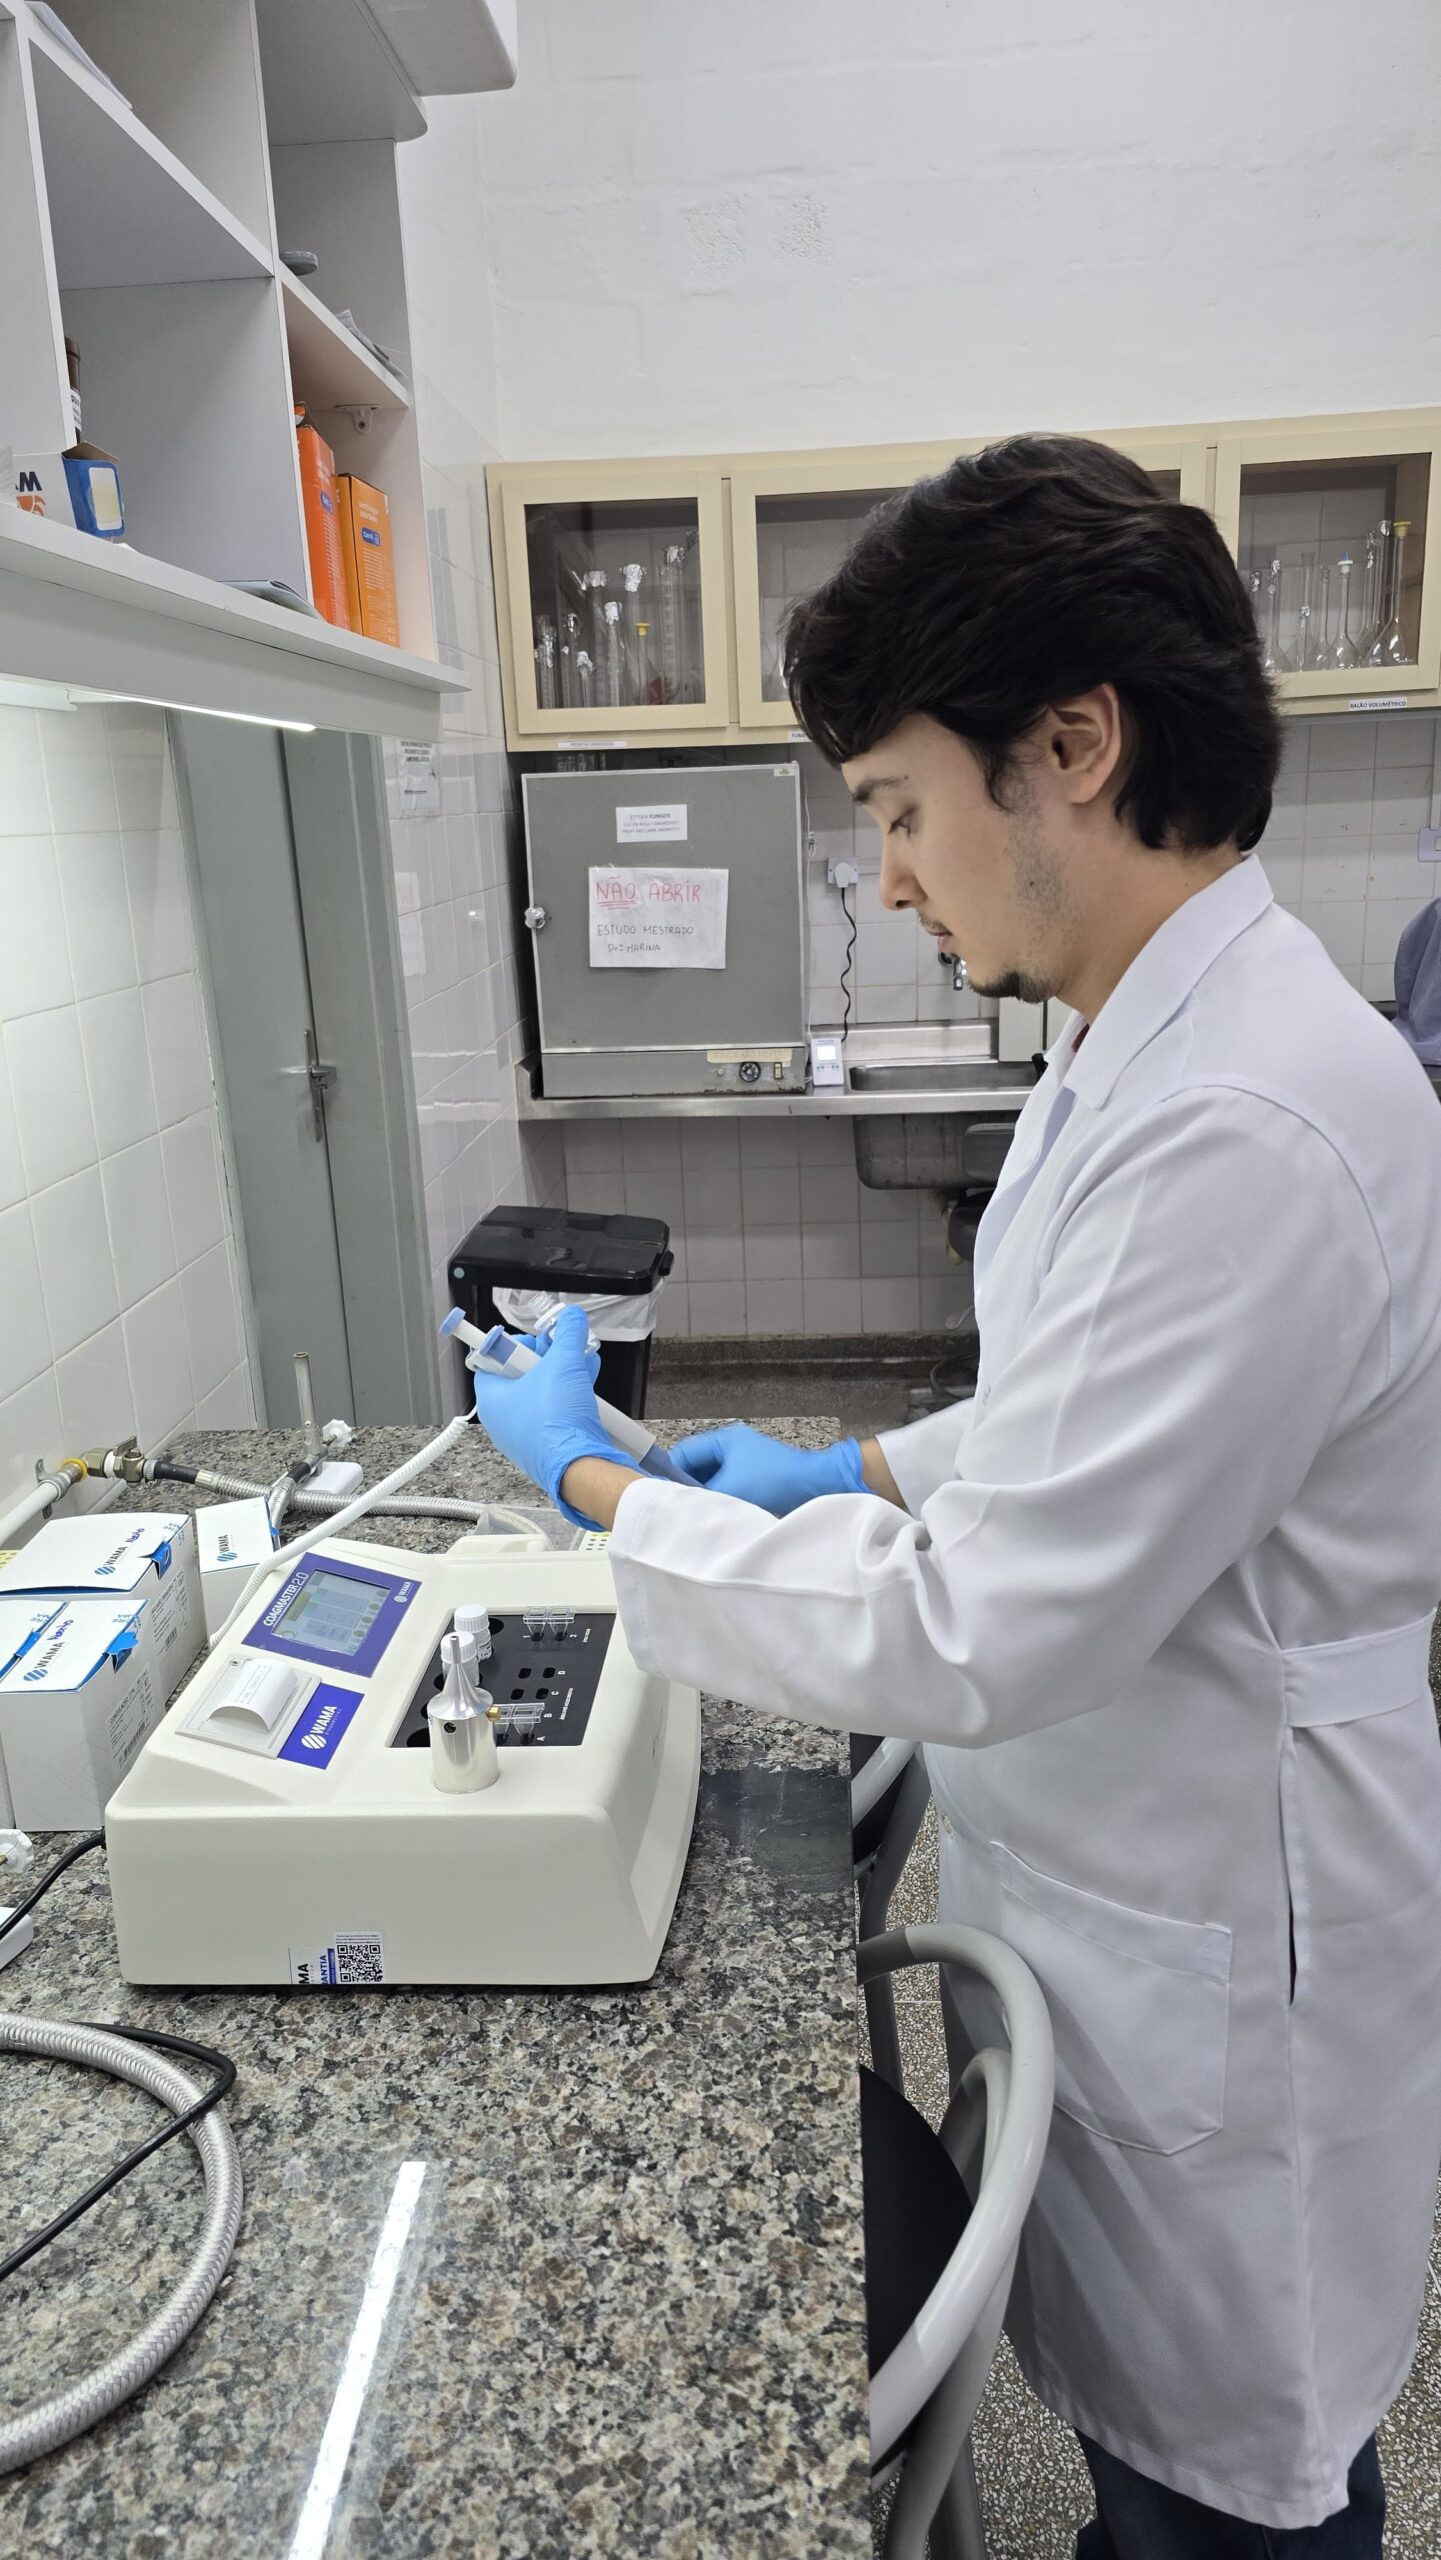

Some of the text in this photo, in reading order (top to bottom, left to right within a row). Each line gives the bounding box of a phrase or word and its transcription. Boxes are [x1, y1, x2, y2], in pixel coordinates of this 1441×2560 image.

[1350, 701, 1368, 709] BALÃO
[596, 875, 702, 904] NÃO ABRIR
[597, 924, 694, 937] ESTUDO MESTRADO
[626, 942, 661, 954] MARINA
[218, 1534, 230, 1554] WAMA
[103, 1545, 129, 1566] WAMA
[399, 1581, 412, 1597] WAMA
[263, 1572, 309, 1627] COAGMASTER 2.0
[34, 1641, 66, 1669] WAMA
[310, 1705, 338, 1735] WAMA
